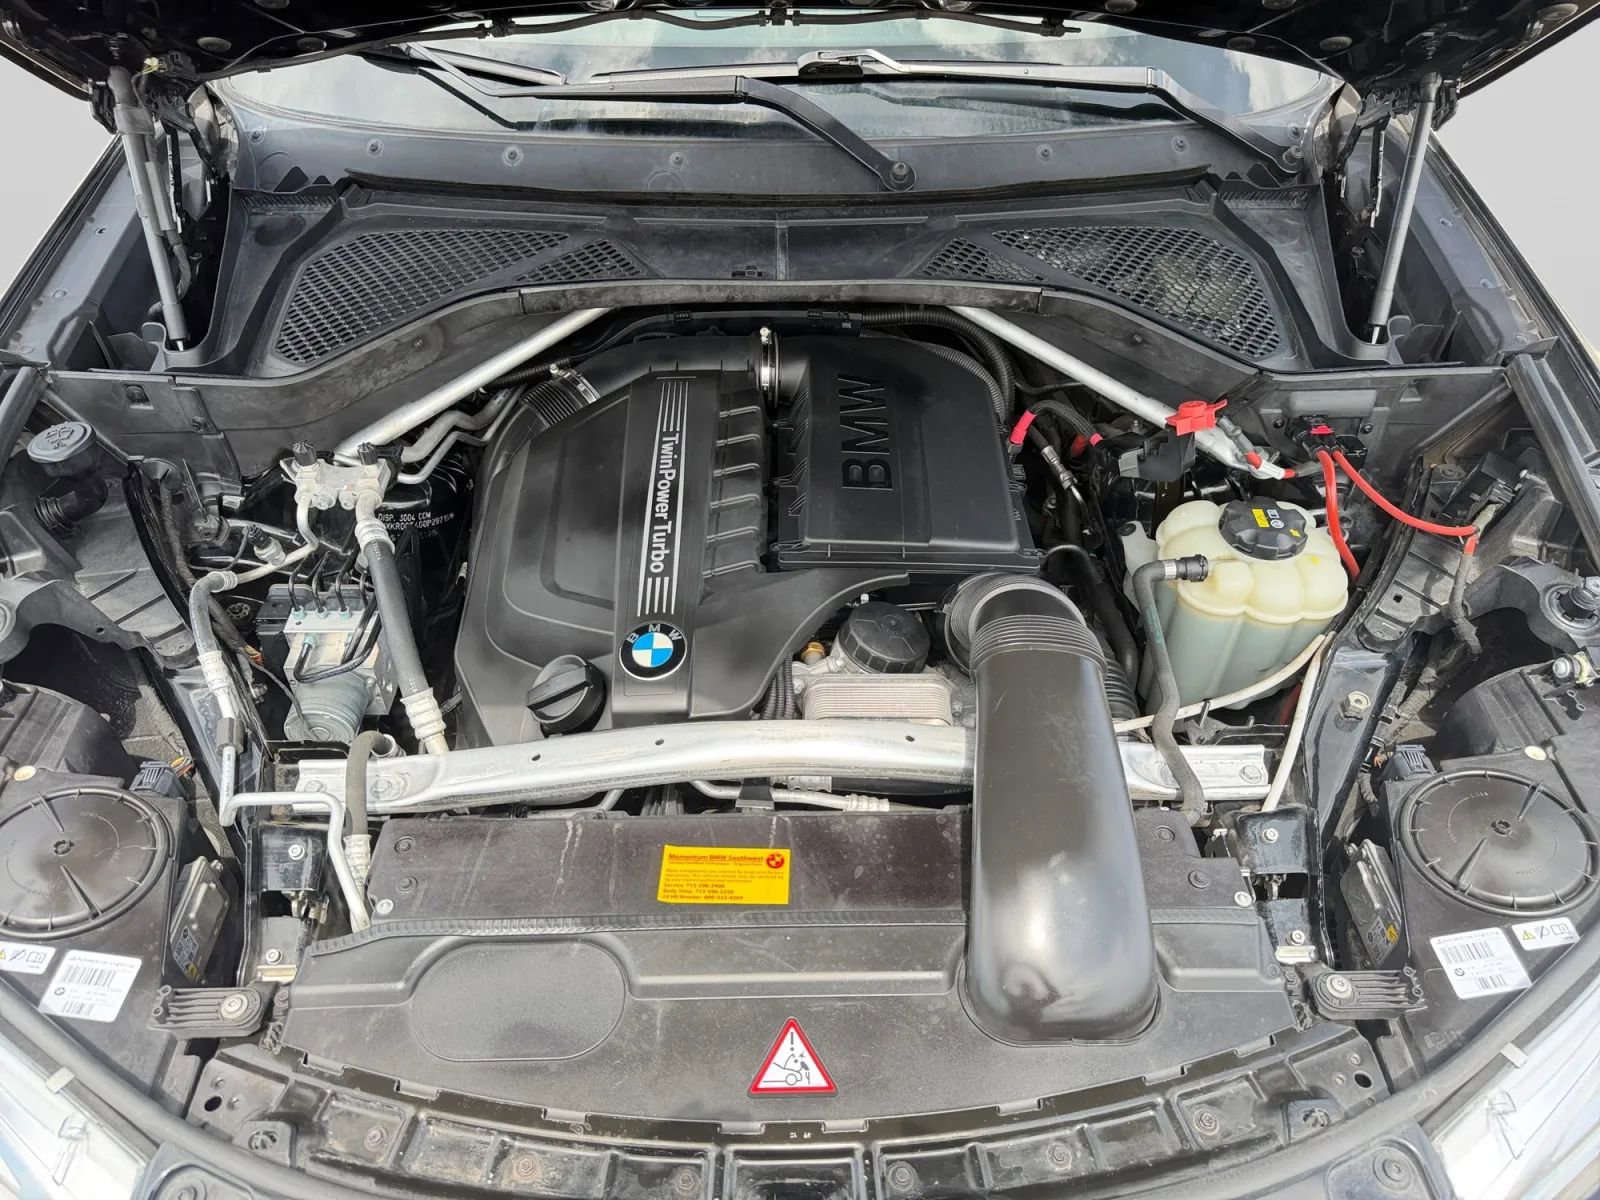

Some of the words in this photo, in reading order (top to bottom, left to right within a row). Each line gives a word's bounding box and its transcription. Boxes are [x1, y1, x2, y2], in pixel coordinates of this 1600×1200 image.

[837, 373, 894, 491] BMW
[655, 432, 680, 520] TwinPower
[649, 520, 673, 574] Turbo
[626, 623, 682, 643] BMW
